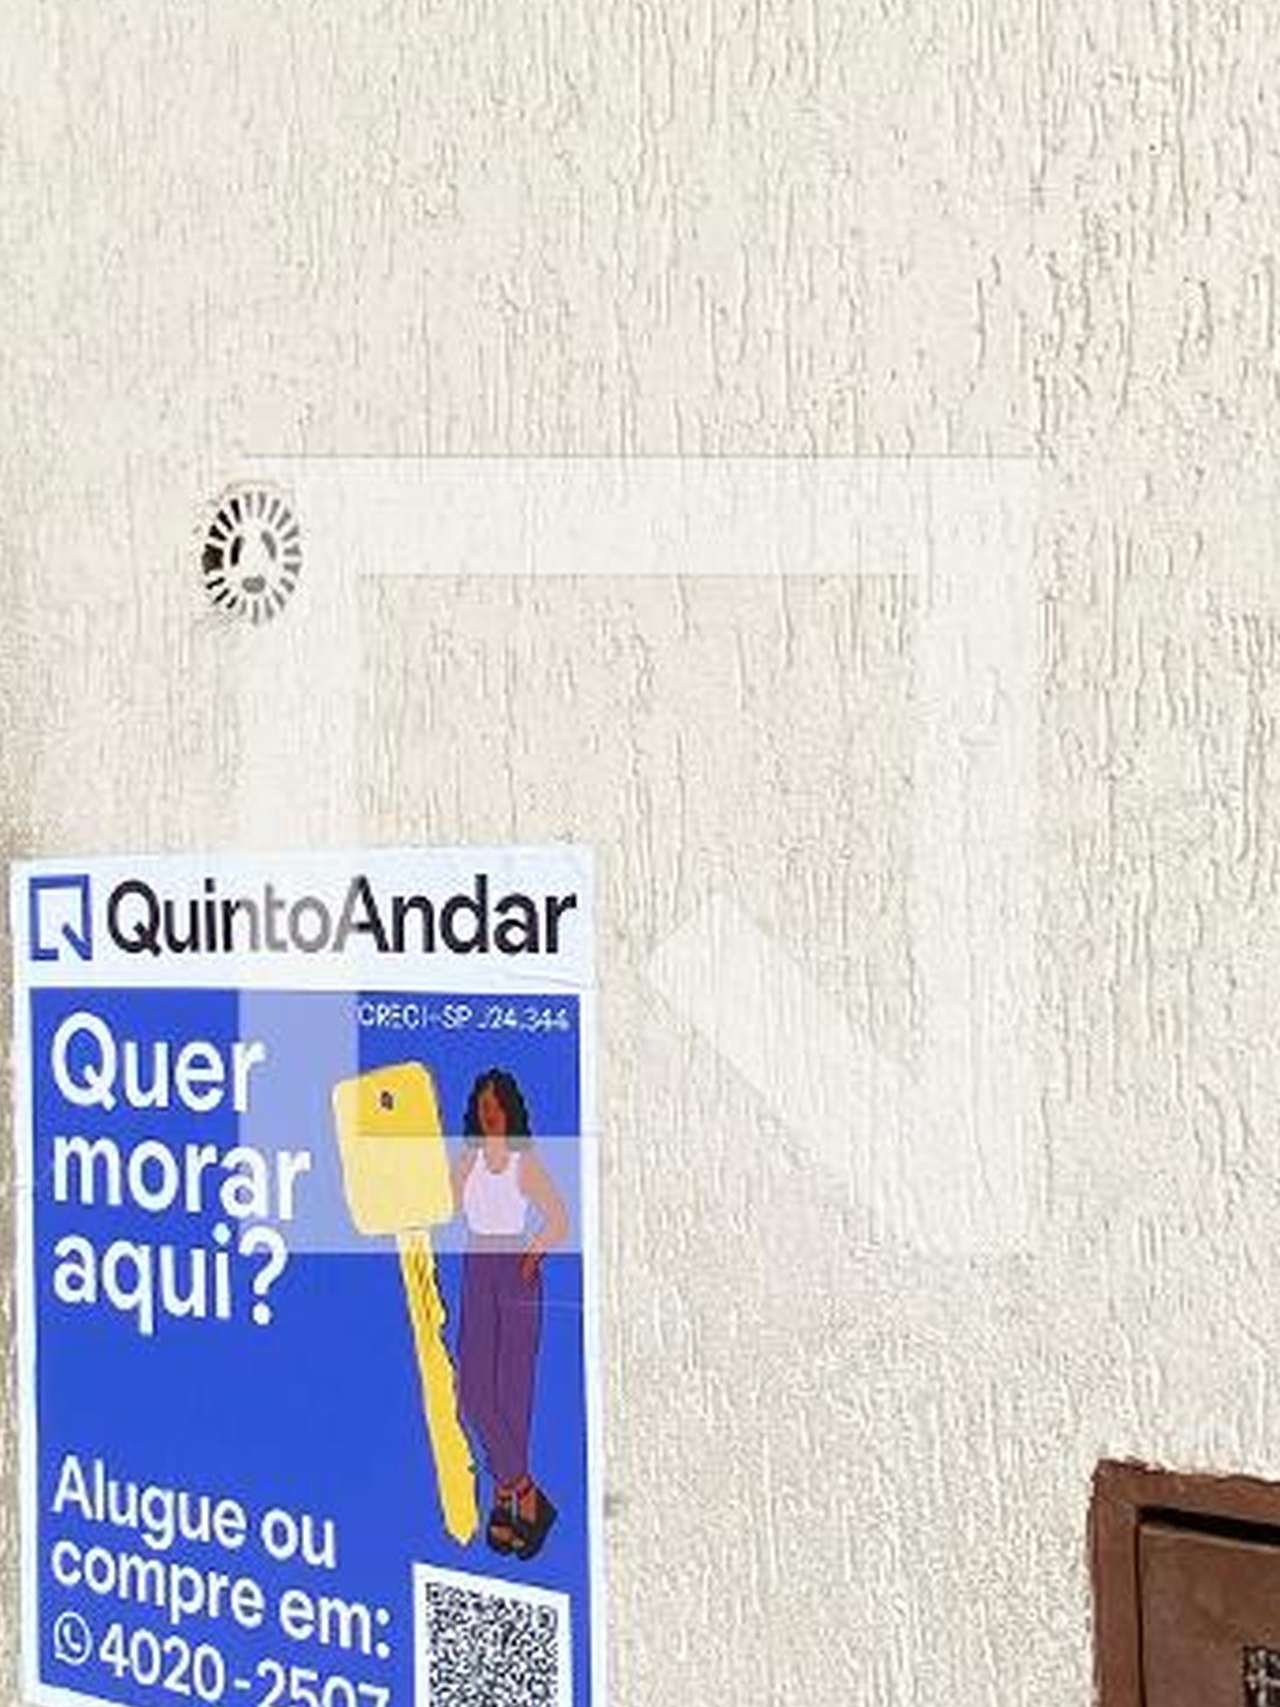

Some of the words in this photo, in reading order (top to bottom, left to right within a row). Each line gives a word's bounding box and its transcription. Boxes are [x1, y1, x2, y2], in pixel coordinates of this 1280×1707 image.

[106, 874, 578, 958] QuintoAndar
[50, 1011, 266, 1112] Quer
[357, 1002, 472, 1030] CRECI-SP
[52, 1134, 312, 1221] morar
[52, 1222, 289, 1336] aqui?
[51, 1454, 247, 1549] Alugue
[260, 1504, 337, 1569] ou
[50, 1539, 265, 1630] compre
[278, 1588, 392, 1660] em:
